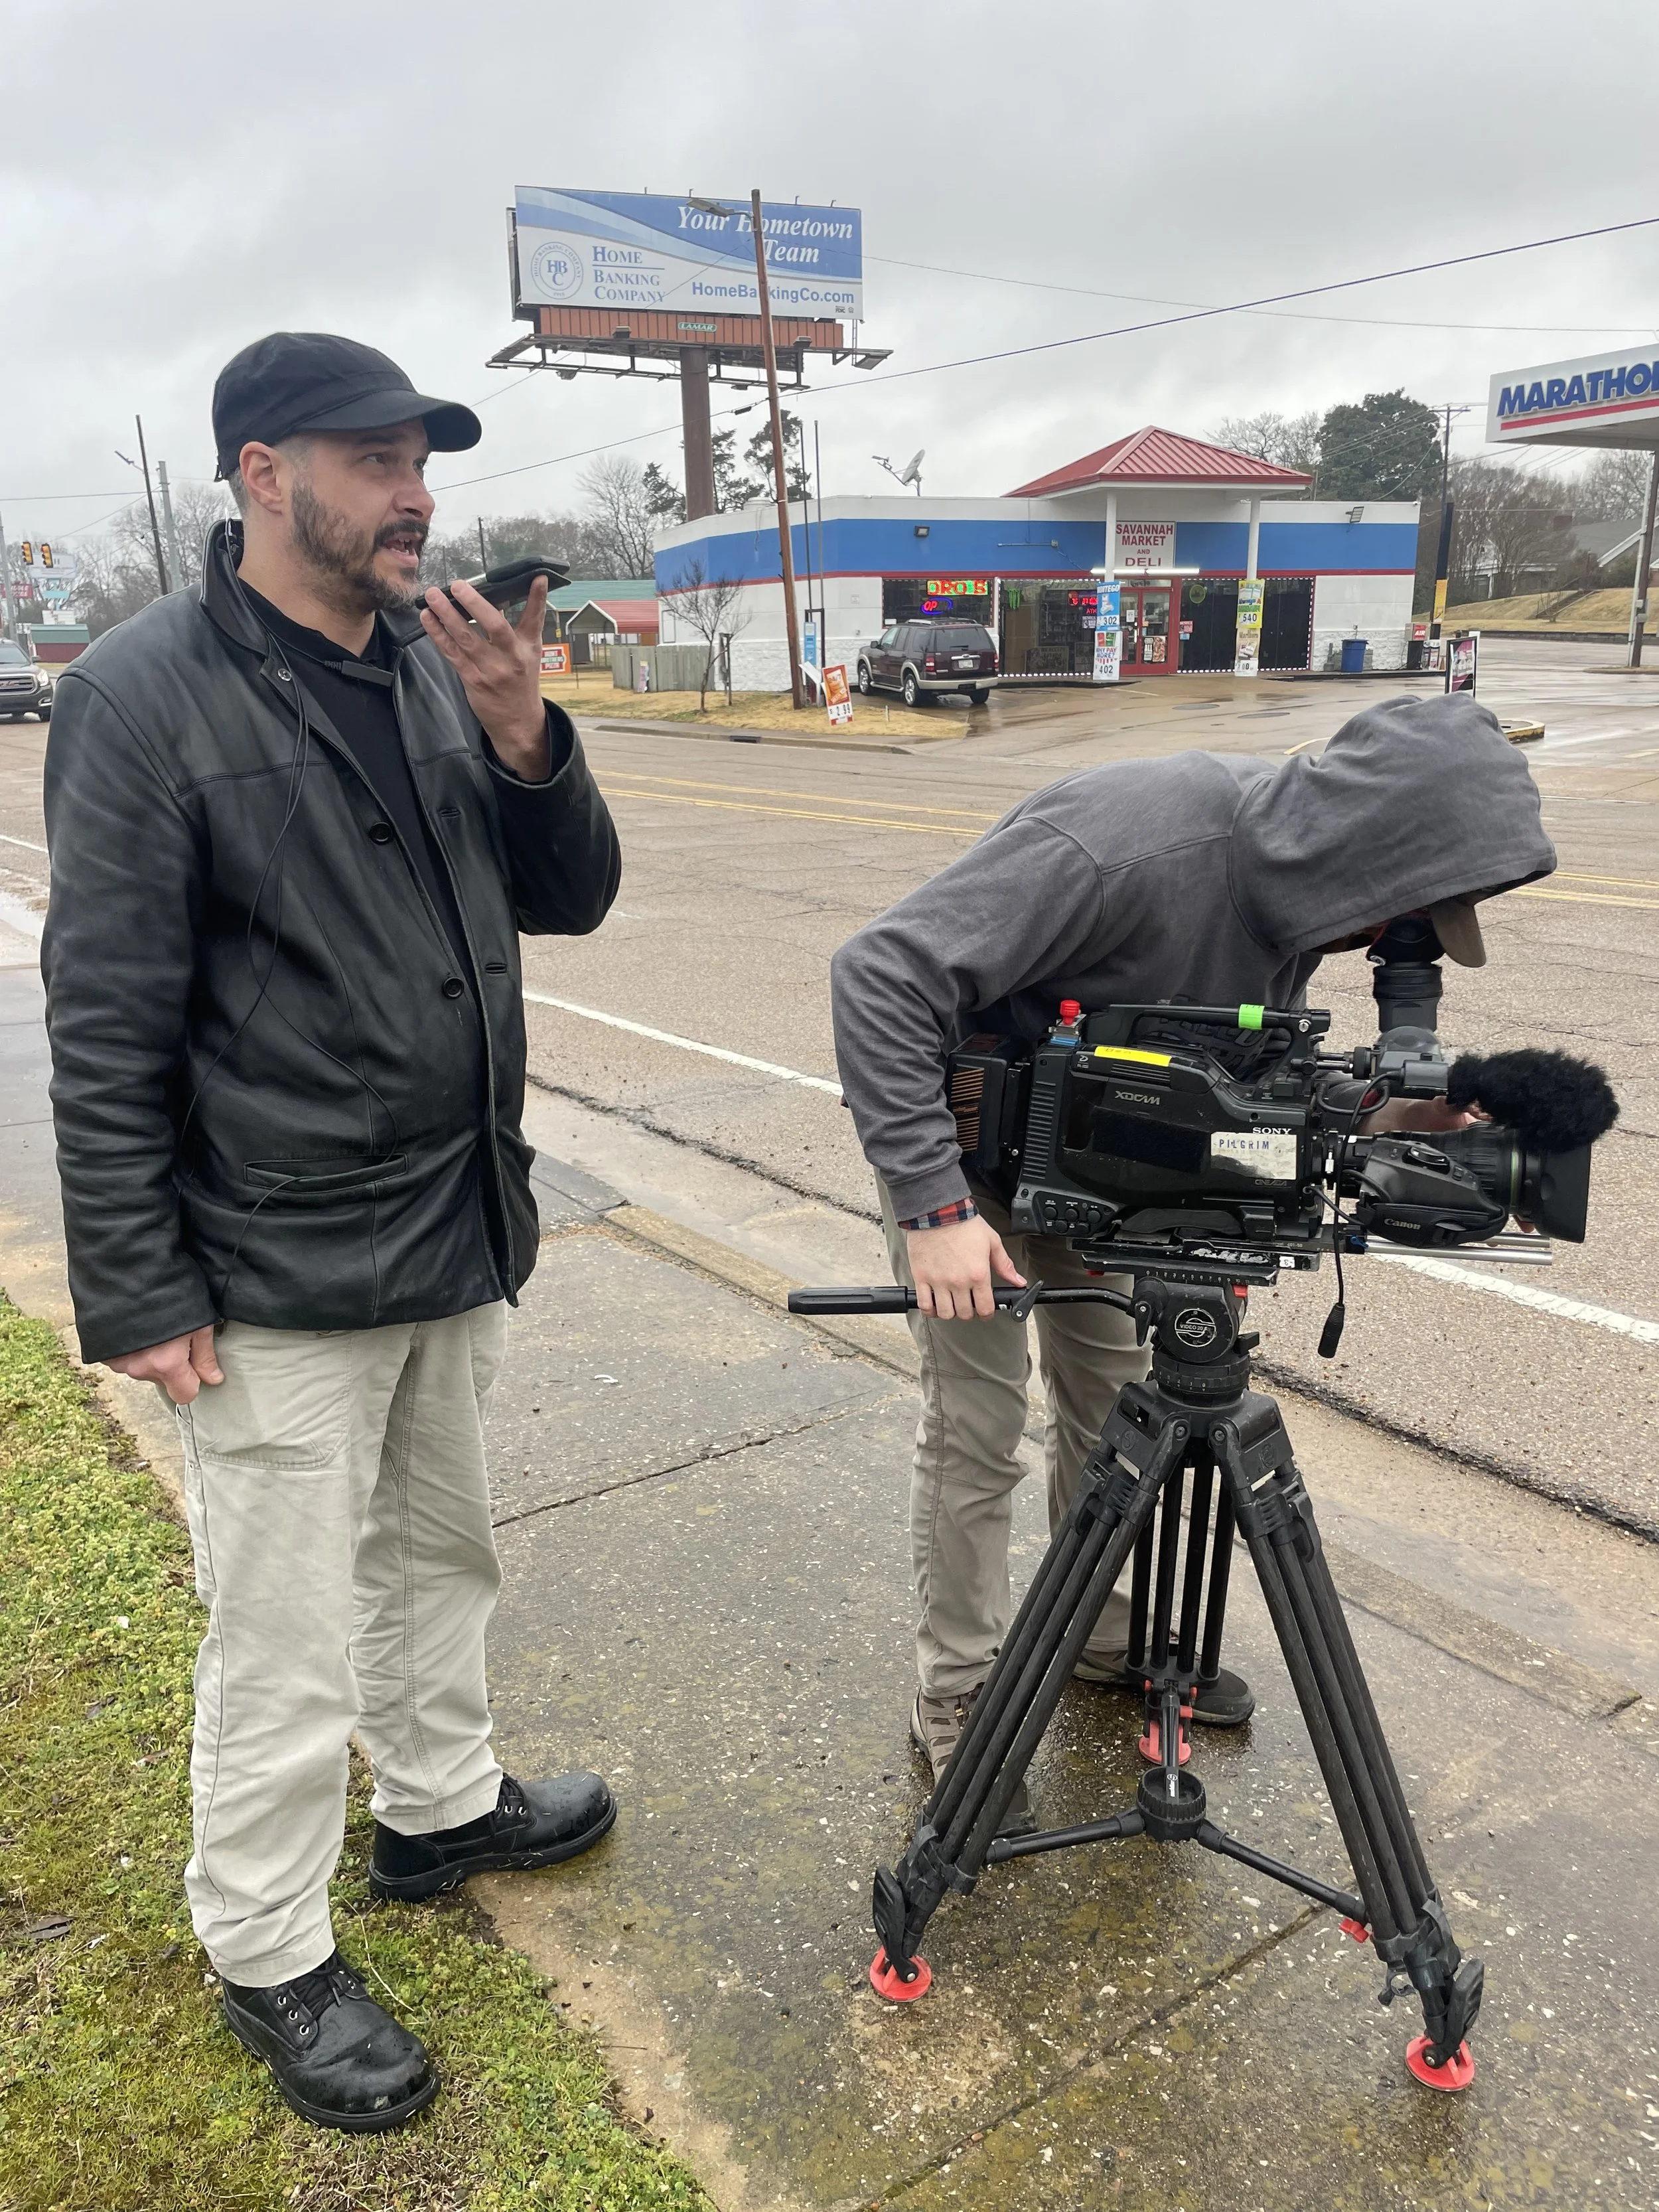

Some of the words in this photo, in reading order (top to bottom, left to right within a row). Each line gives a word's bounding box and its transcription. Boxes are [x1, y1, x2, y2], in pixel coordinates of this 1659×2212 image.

[677, 206, 730, 232] Your
[735, 211, 853, 239] Hometown
[592, 246, 643, 264] HOME
[762, 239, 820, 263] Team
[593, 269, 660, 286] BANKING
[595, 285, 666, 303] COMPANY
[692, 282, 855, 304] HomeBakingCo.com
[1496, 361, 1659, 418] MARATHO
[1116, 524, 1173, 535] SAVANNAH
[1121, 535, 1166, 546] MARKET
[1125, 557, 1161, 567] DELI
[1103, 616, 1118, 625] 302
[1243, 613, 1258, 623] 540
[1099, 665, 1114, 674] 402
[1115, 1090, 1161, 1105] XDCAM
[1219, 1139, 1269, 1150] PILGRIM
[1384, 1218, 1421, 1230] Canon
